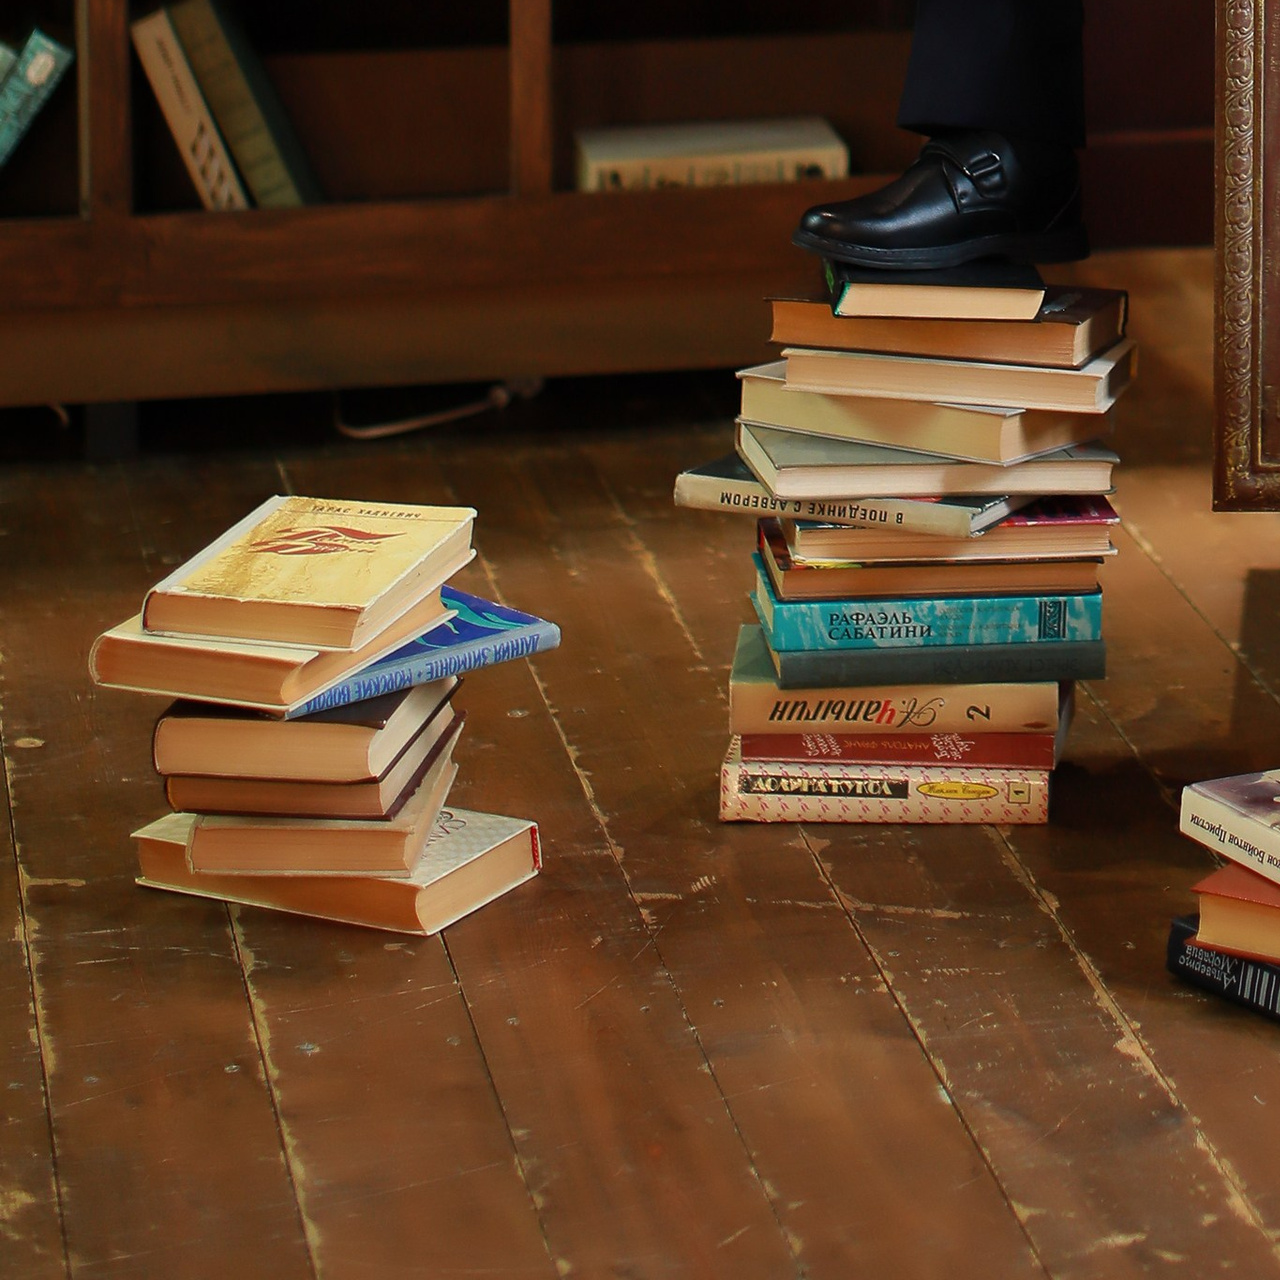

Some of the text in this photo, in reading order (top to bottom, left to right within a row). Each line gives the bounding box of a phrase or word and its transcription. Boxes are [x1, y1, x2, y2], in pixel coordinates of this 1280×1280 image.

[719, 490, 905, 525] В ПОЕДИНКЕ С АБВЕРОМ
[828, 624, 935, 641] САБАТИНИ
[829, 610, 913, 628] РАФАЭЛЬ
[354, 666, 415, 699] МОРСКИЕ
[966, 704, 993, 721] 2
[1189, 813, 1228, 844] Пристли
[1227, 830, 1267, 863] Бойнтон
